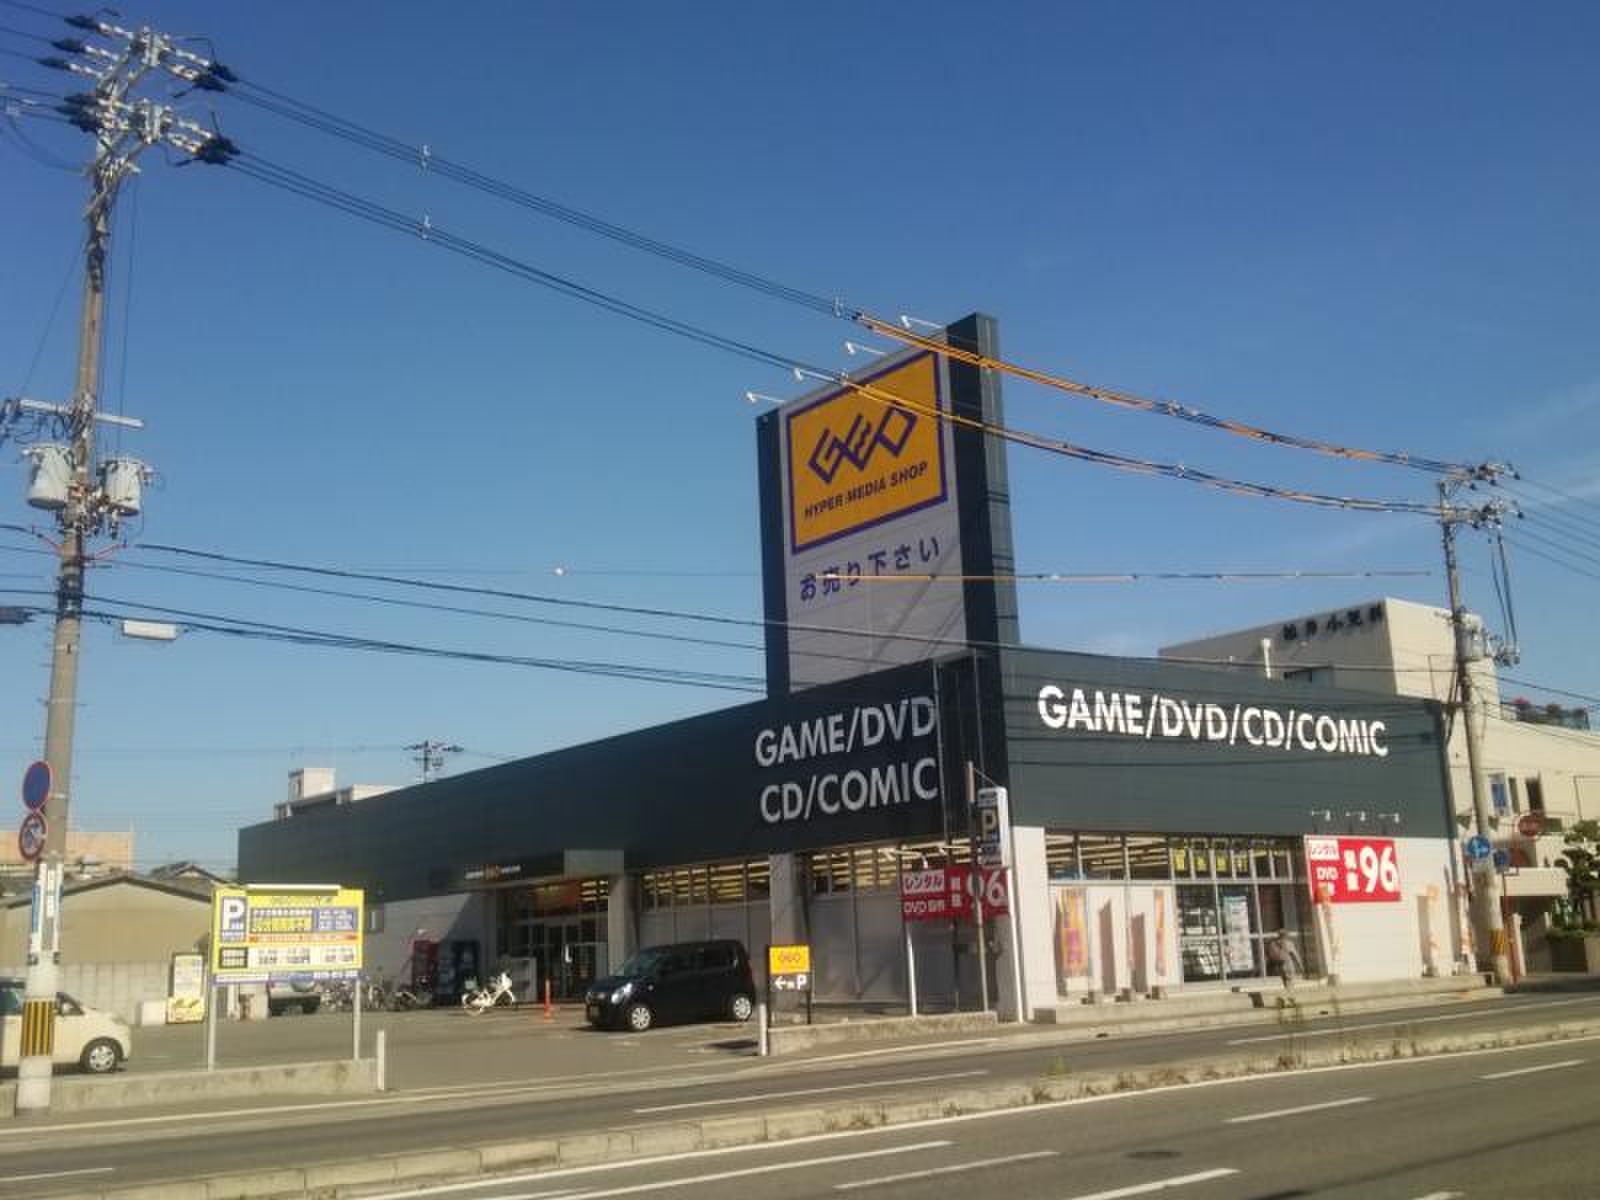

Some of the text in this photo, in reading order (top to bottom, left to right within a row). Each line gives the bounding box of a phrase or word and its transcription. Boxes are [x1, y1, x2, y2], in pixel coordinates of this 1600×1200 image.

[808, 402, 918, 483] GEO
[803, 460, 928, 519] HYPER MEDIA SHOP
[799, 536, 941, 602] お売り下さい
[755, 695, 937, 768] GAME/DVD
[1037, 685, 1390, 757] GAME/DVD/CD/COMIC
[759, 757, 939, 824] CD/COMIC
[1359, 846, 1399, 894] 96
[223, 898, 245, 930] P
[796, 974, 807, 990] P
